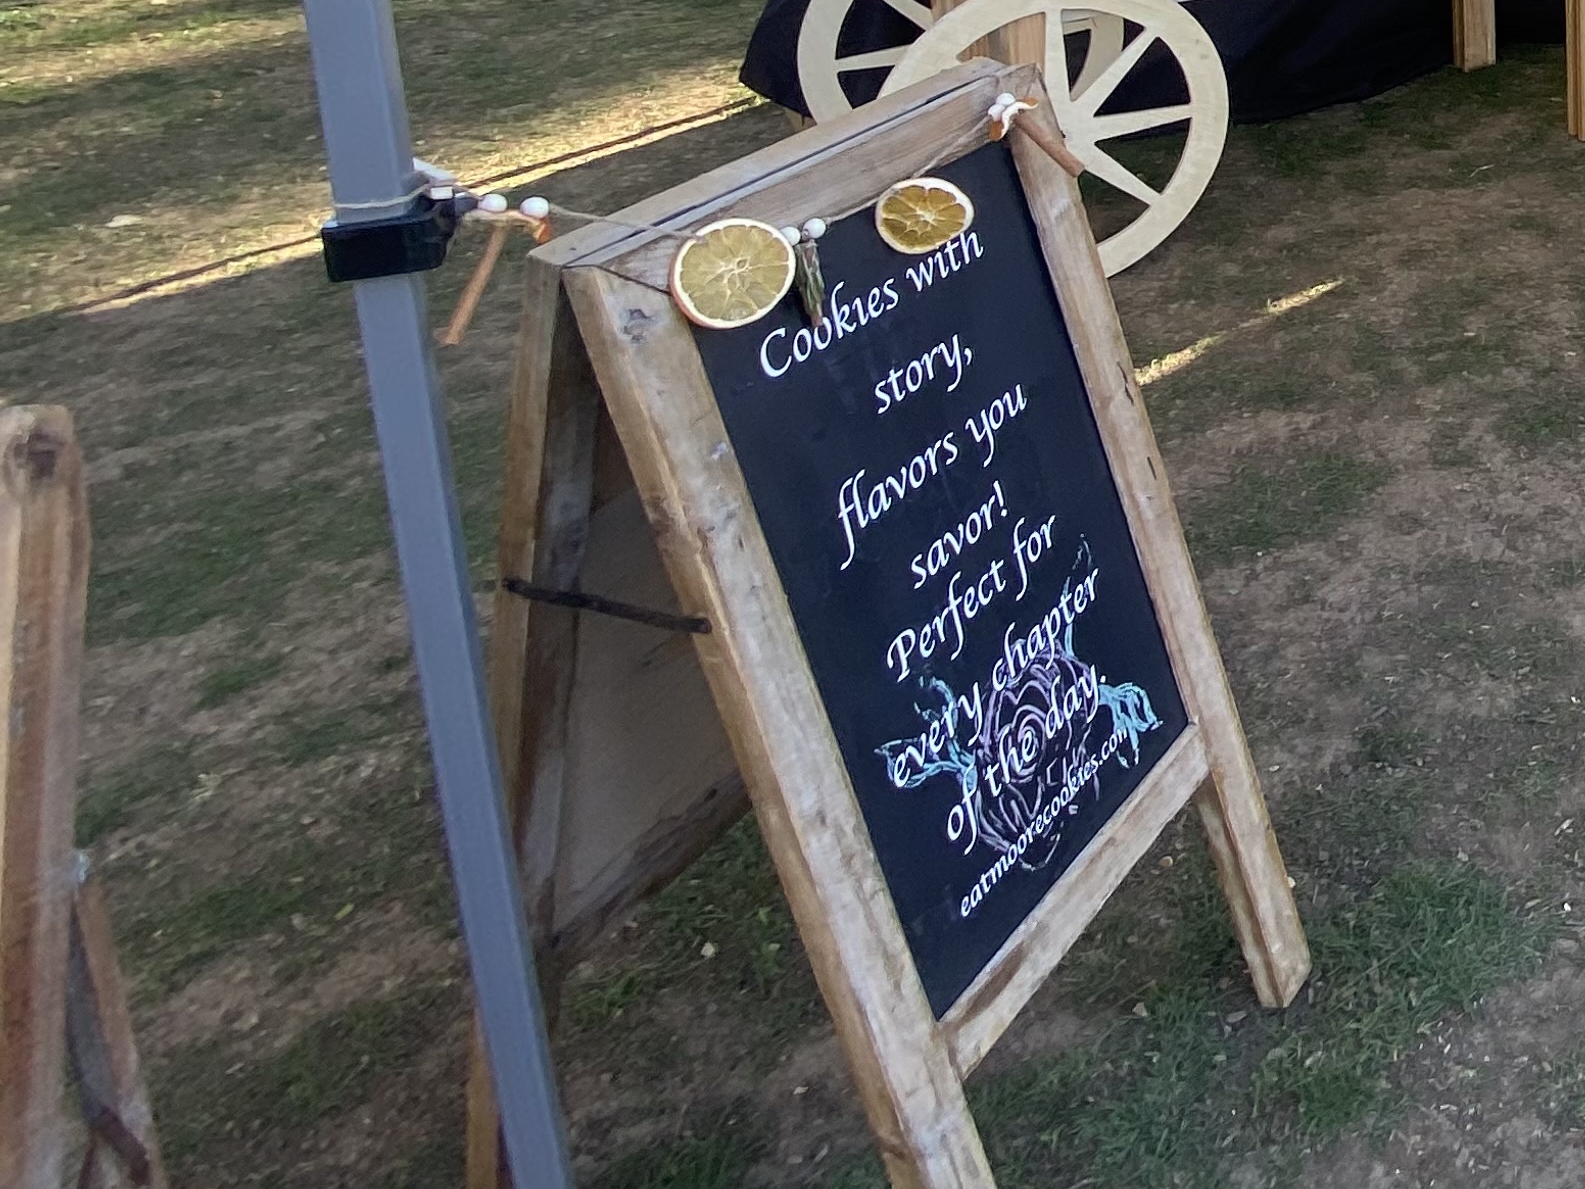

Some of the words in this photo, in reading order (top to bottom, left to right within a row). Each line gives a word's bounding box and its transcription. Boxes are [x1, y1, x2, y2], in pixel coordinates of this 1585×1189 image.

[759, 280, 900, 378] Cookies
[905, 231, 984, 292] with
[874, 334, 974, 414] story,
[837, 431, 960, 571] flavors
[964, 383, 1029, 468] you
[910, 479, 1009, 590] savor!
[886, 559, 1007, 683] Perfect
[1012, 514, 1056, 601] for
[892, 681, 984, 788] every
[992, 567, 1099, 692] chapter
[947, 778, 978, 856] of
[984, 724, 1038, 798] the
[1045, 663, 1107, 740] day.
